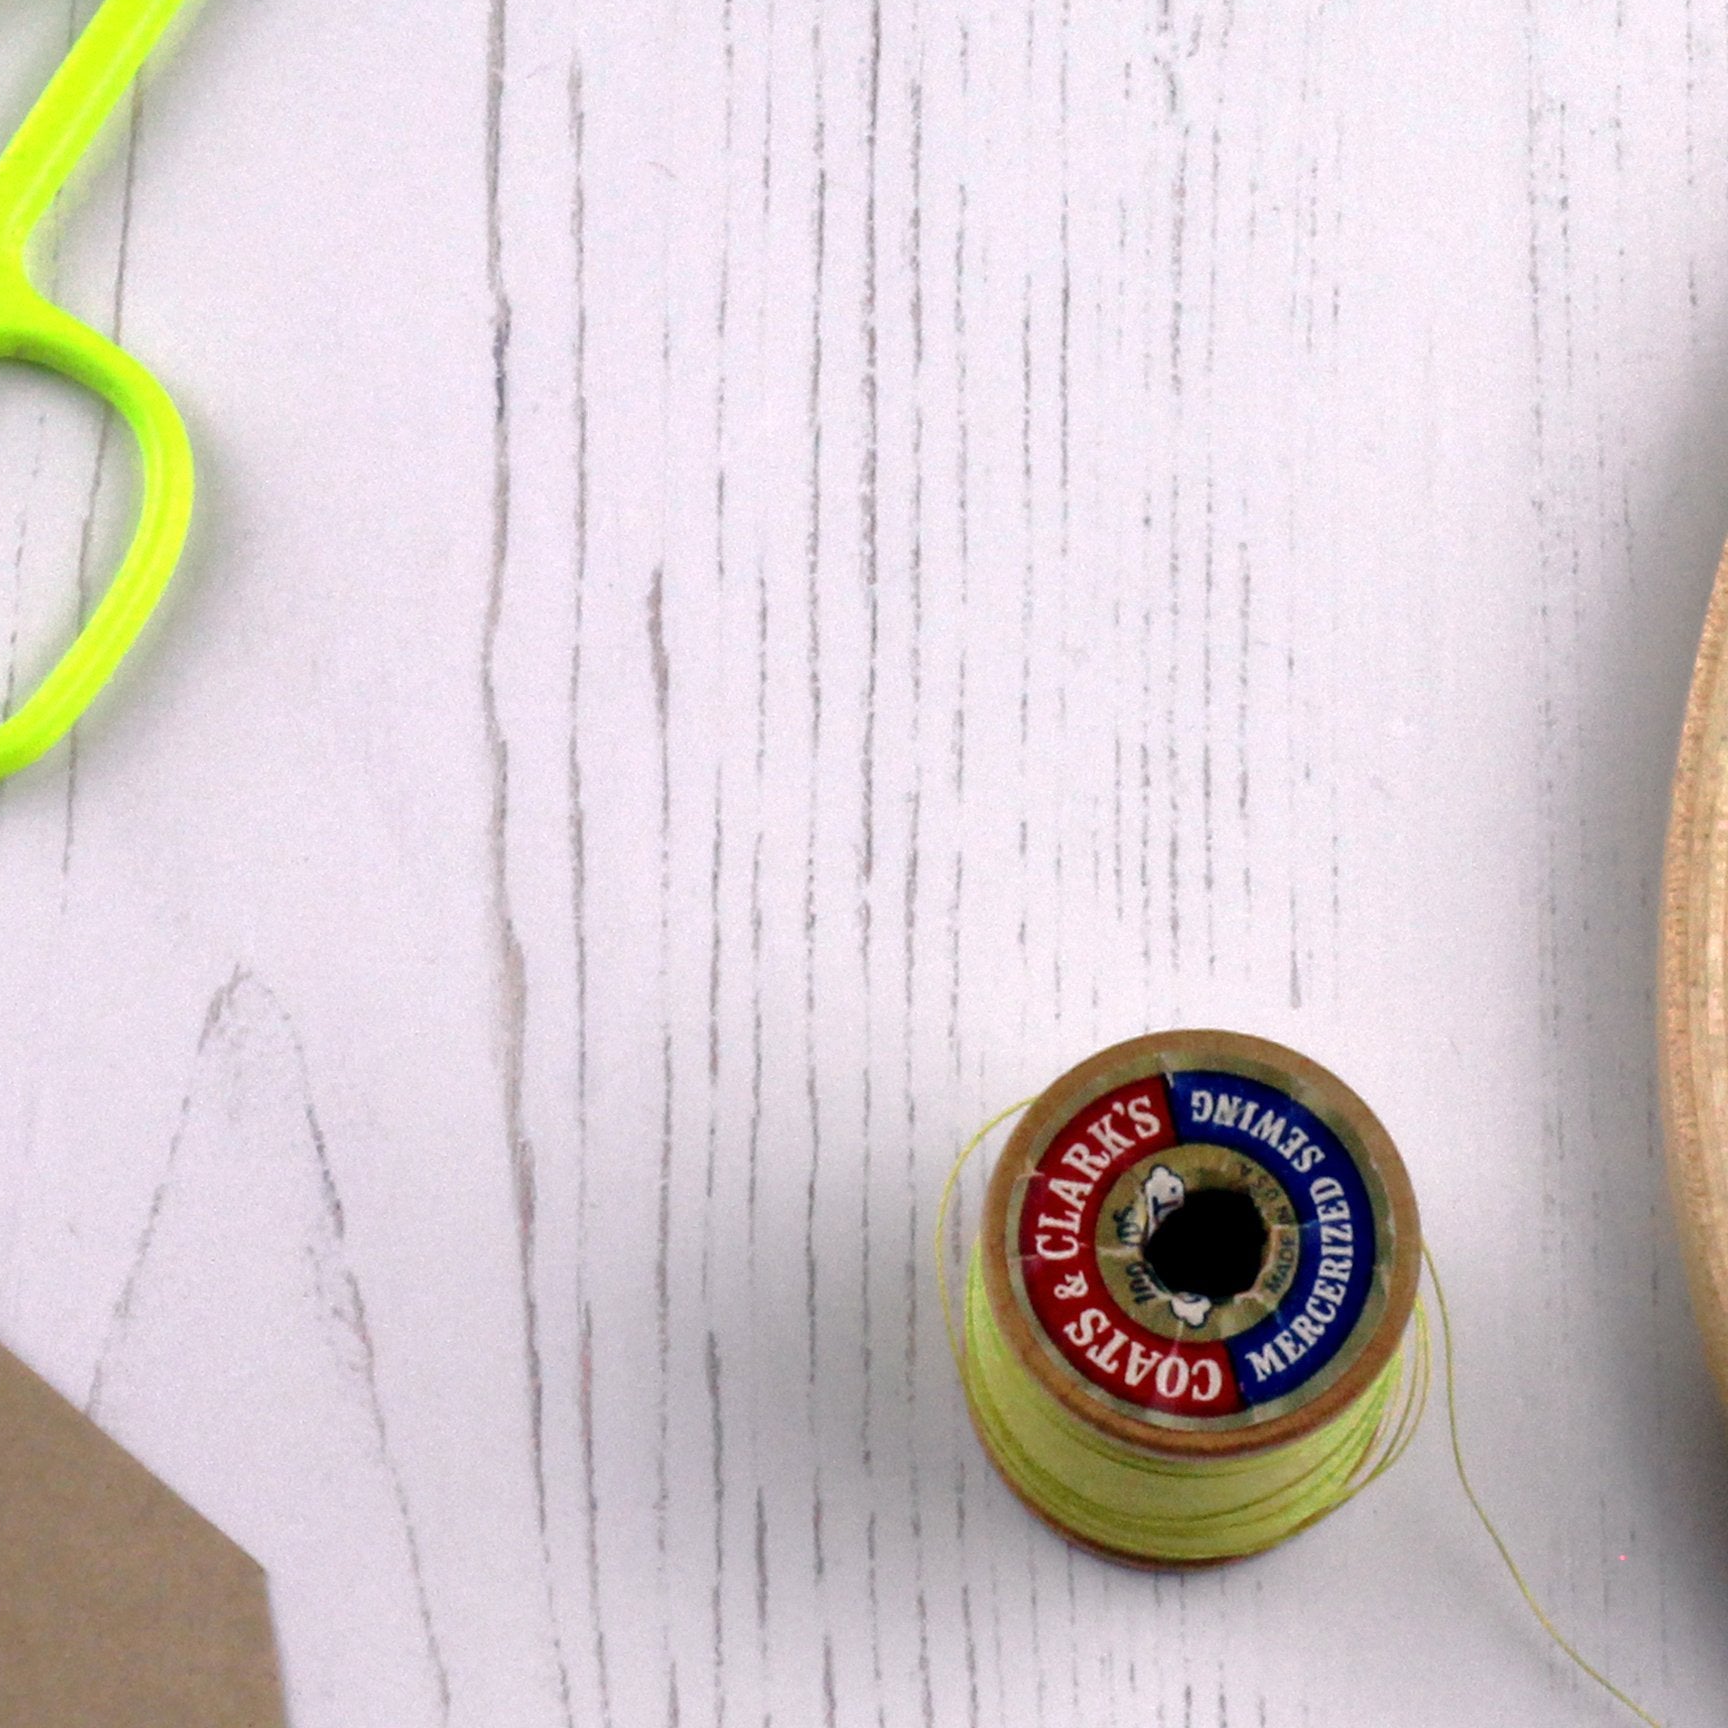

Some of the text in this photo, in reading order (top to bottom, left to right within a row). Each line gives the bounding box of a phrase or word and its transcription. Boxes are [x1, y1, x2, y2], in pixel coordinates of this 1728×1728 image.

[1035, 1095, 1222, 1401] COATS & CLARK'S
[1191, 1090, 1354, 1382] MERCERIZED SEWING
